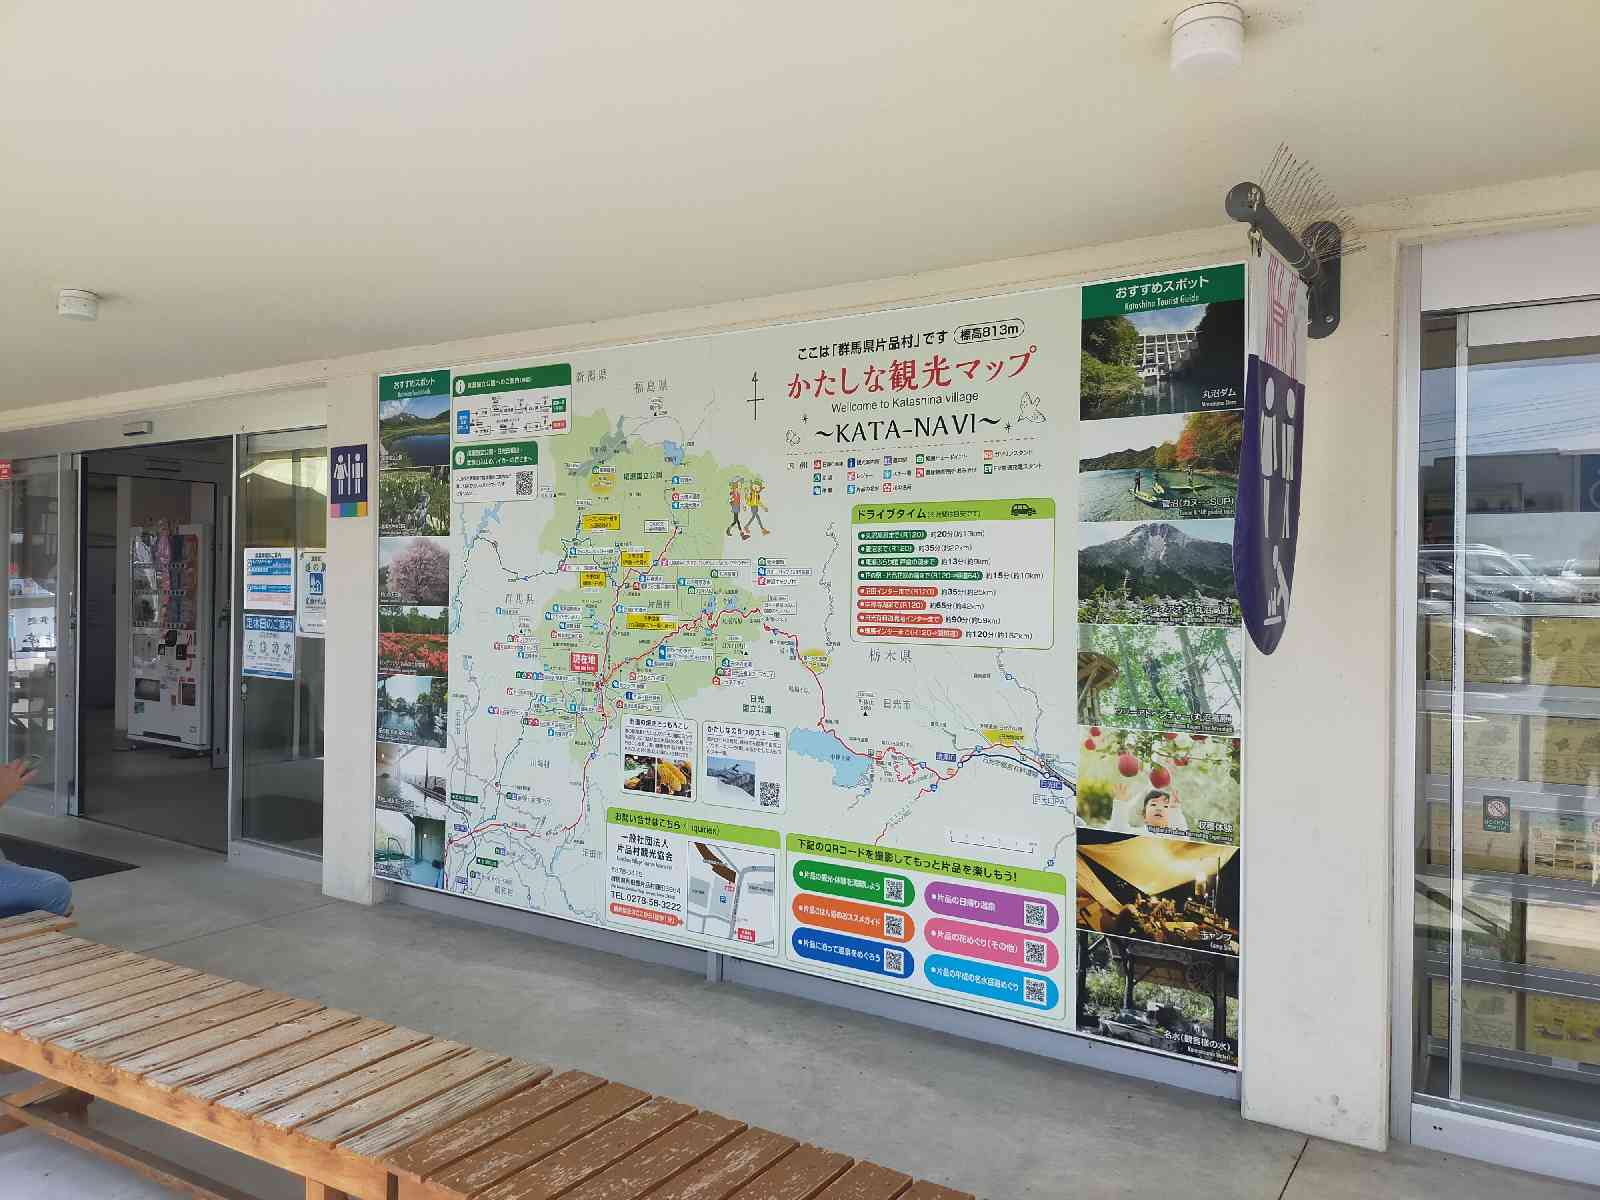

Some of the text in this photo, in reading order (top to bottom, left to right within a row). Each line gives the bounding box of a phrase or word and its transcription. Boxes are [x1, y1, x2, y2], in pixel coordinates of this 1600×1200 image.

[1115, 275, 1209, 299] おすすめスポット
[1157, 297, 1179, 308] Tourist
[1180, 293, 1200, 304] Guide
[959, 322, 1020, 342] 標高813m
[797, 329, 950, 360] ここは「群馬県片品村」です
[787, 344, 1038, 400] かたしな観光マップ
[879, 399, 890, 410] to
[945, 391, 979, 404] village
[1201, 387, 1236, 400] 丸沼ダム
[623, 471, 663, 481] 尾瀬国立公園
[857, 509, 927, 520] ドライブタイム
[572, 653, 596, 664] 現在地
[868, 648, 913, 664] 栃木県
[750, 695, 765, 703] 日光
[742, 703, 772, 715] 国立公園
[615, 812, 681, 829] お問い合せはこちら
[616, 844, 673, 862] 片品村観光協会
[936, 893, 996, 912] 片品の日帰り温泉
[936, 929, 1019, 954] 片品の花めぐり(その他)
[1199, 930, 1232, 942] キャンプ
